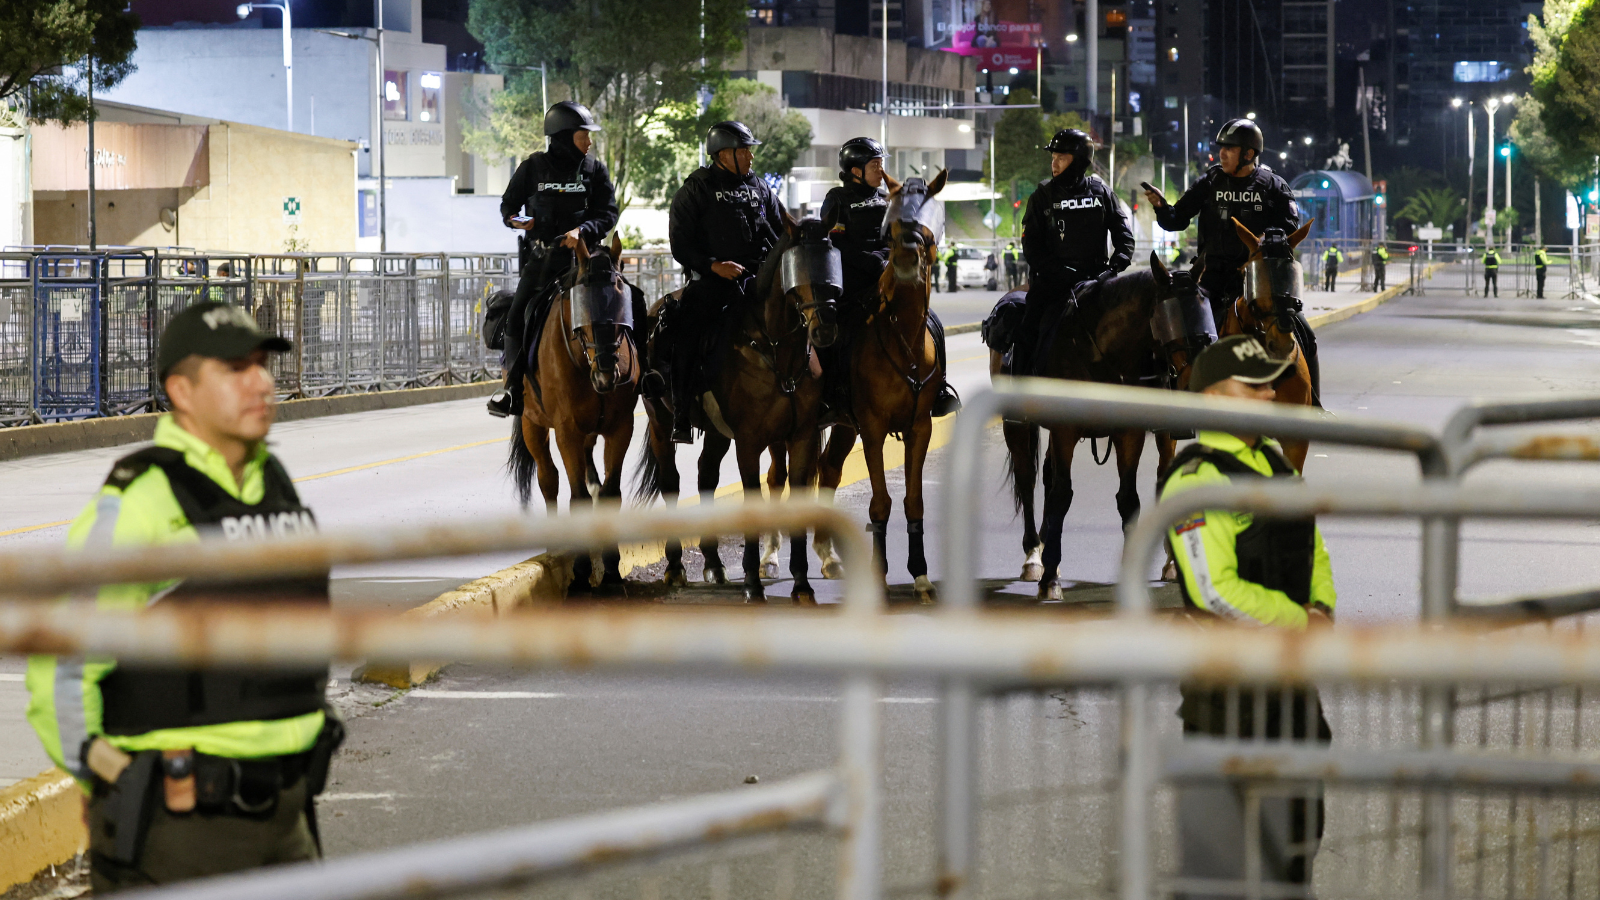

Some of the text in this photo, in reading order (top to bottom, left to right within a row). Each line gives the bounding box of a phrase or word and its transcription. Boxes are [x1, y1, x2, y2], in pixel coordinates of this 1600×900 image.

[937, 22, 945, 31] El
[948, 23, 975, 33] mejor
[978, 23, 1008, 31] banco
[1009, 24, 1031, 33] para
[1215, 191, 1262, 203] POLICIA
[1061, 197, 1102, 210] POLICIA
